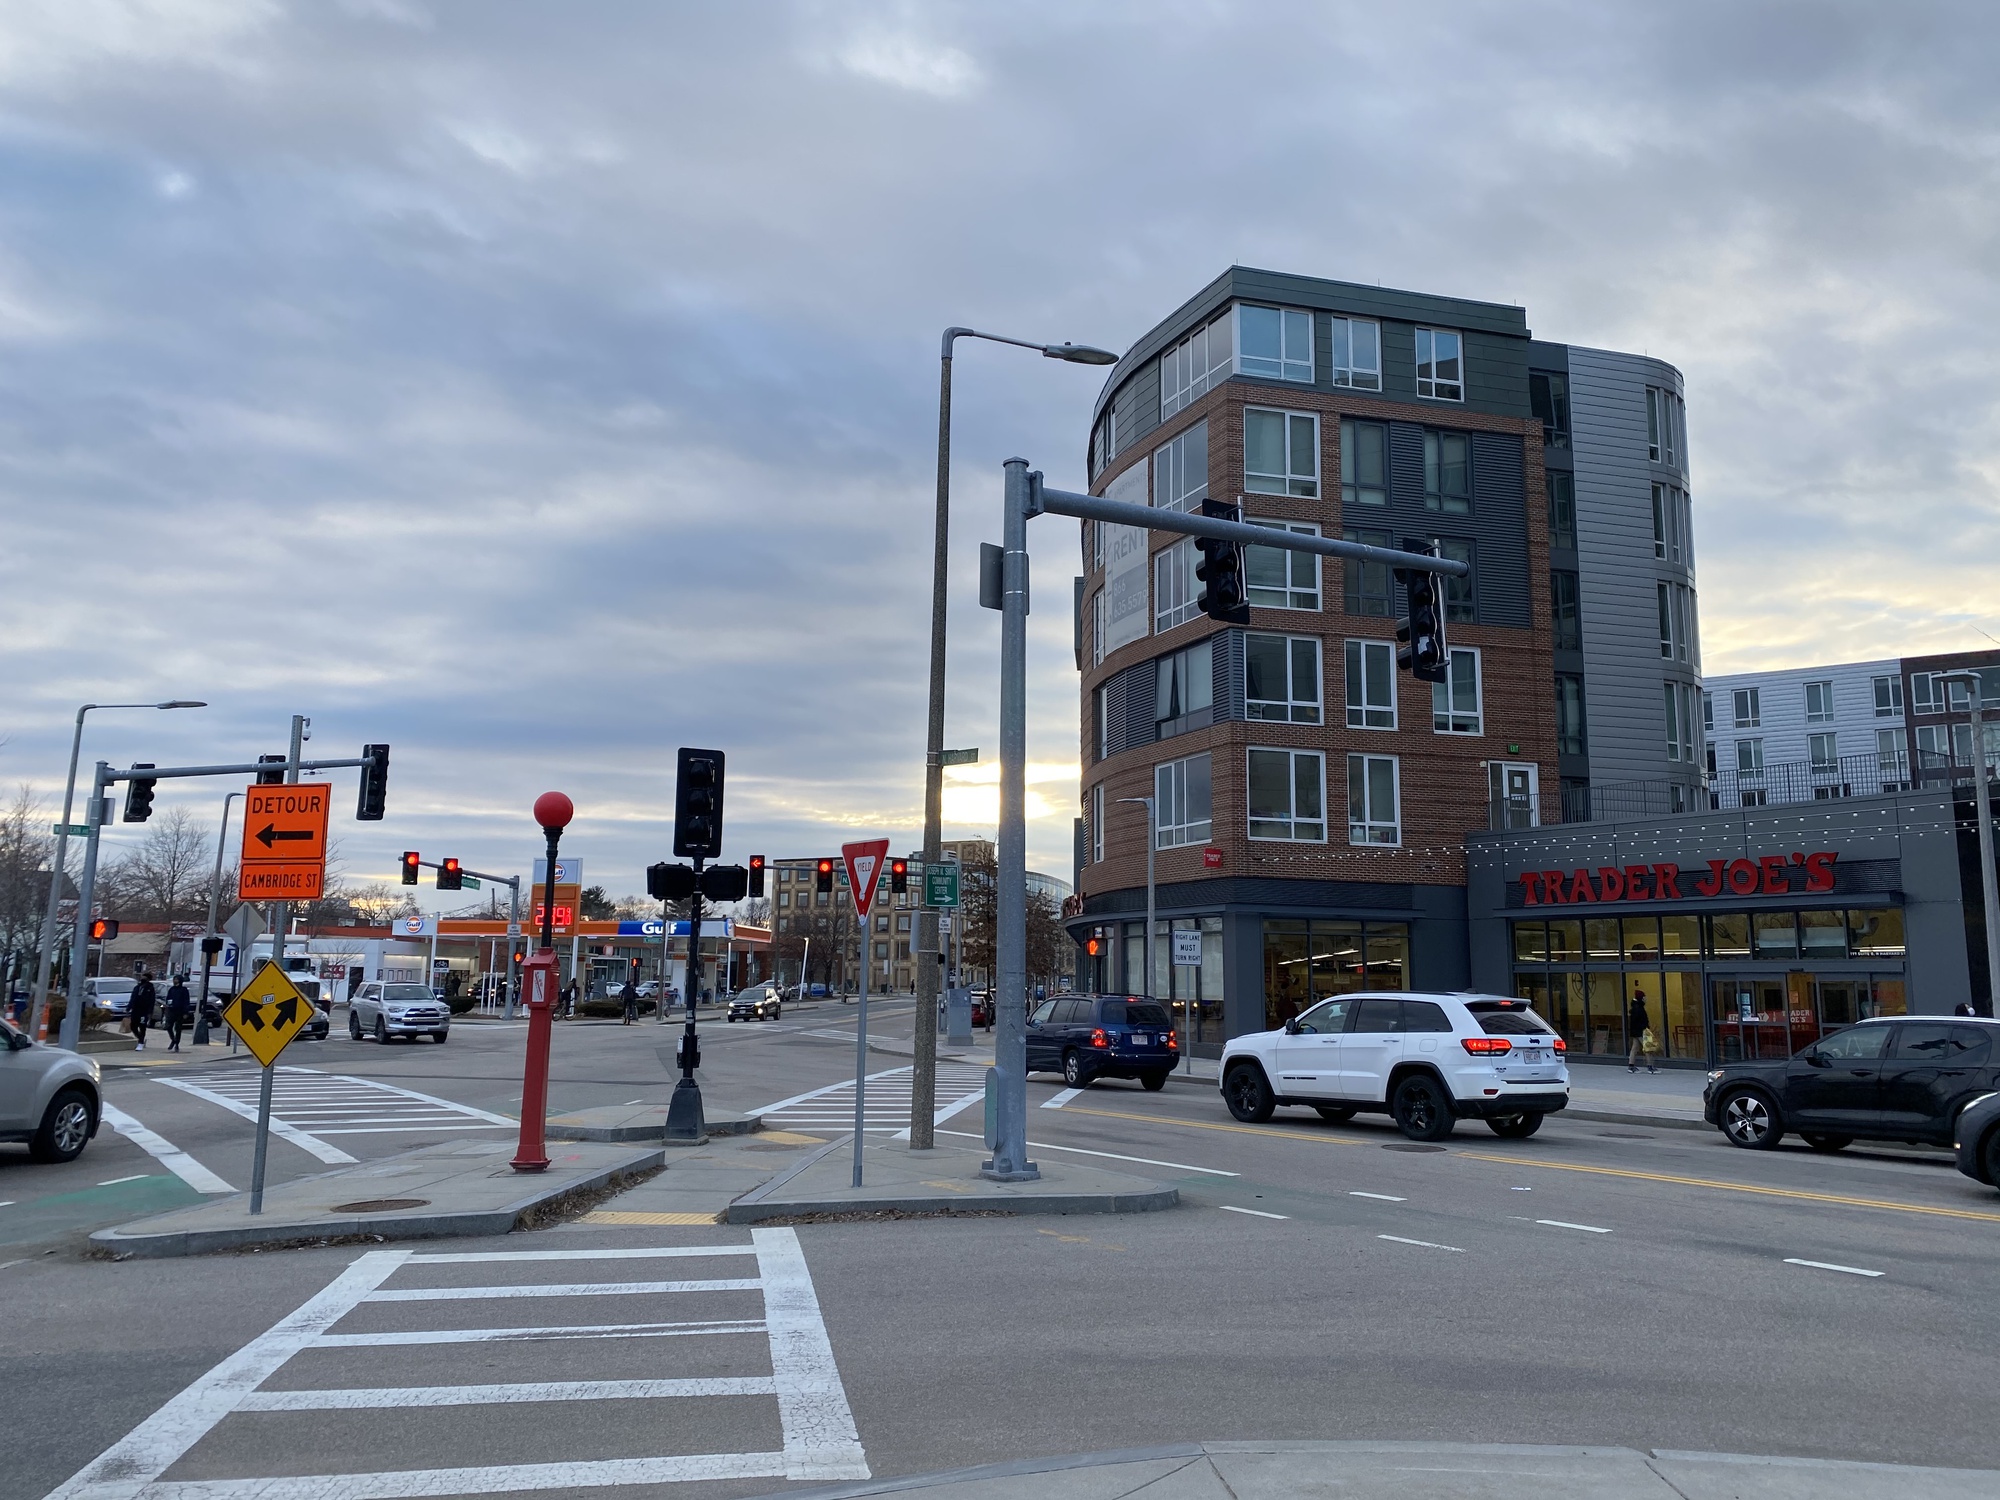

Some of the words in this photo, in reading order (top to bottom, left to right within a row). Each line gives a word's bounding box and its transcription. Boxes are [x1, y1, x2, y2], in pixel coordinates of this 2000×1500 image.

[1114, 471, 1148, 497] APARTMENTS
[1113, 529, 1144, 562] RENT
[1113, 580, 1126, 597] 866
[252, 796, 321, 814] DETOUR
[857, 861, 872, 872] YIELD
[244, 874, 302, 888] CAMBRIDGE
[306, 873, 318, 888] ST
[932, 876, 952, 885] COMMUNITY
[1519, 863, 1683, 905] TRADER
[1695, 851, 1839, 897] JOE'S
[934, 885, 948, 894] CENTER
[1180, 944, 1196, 952] MUST
